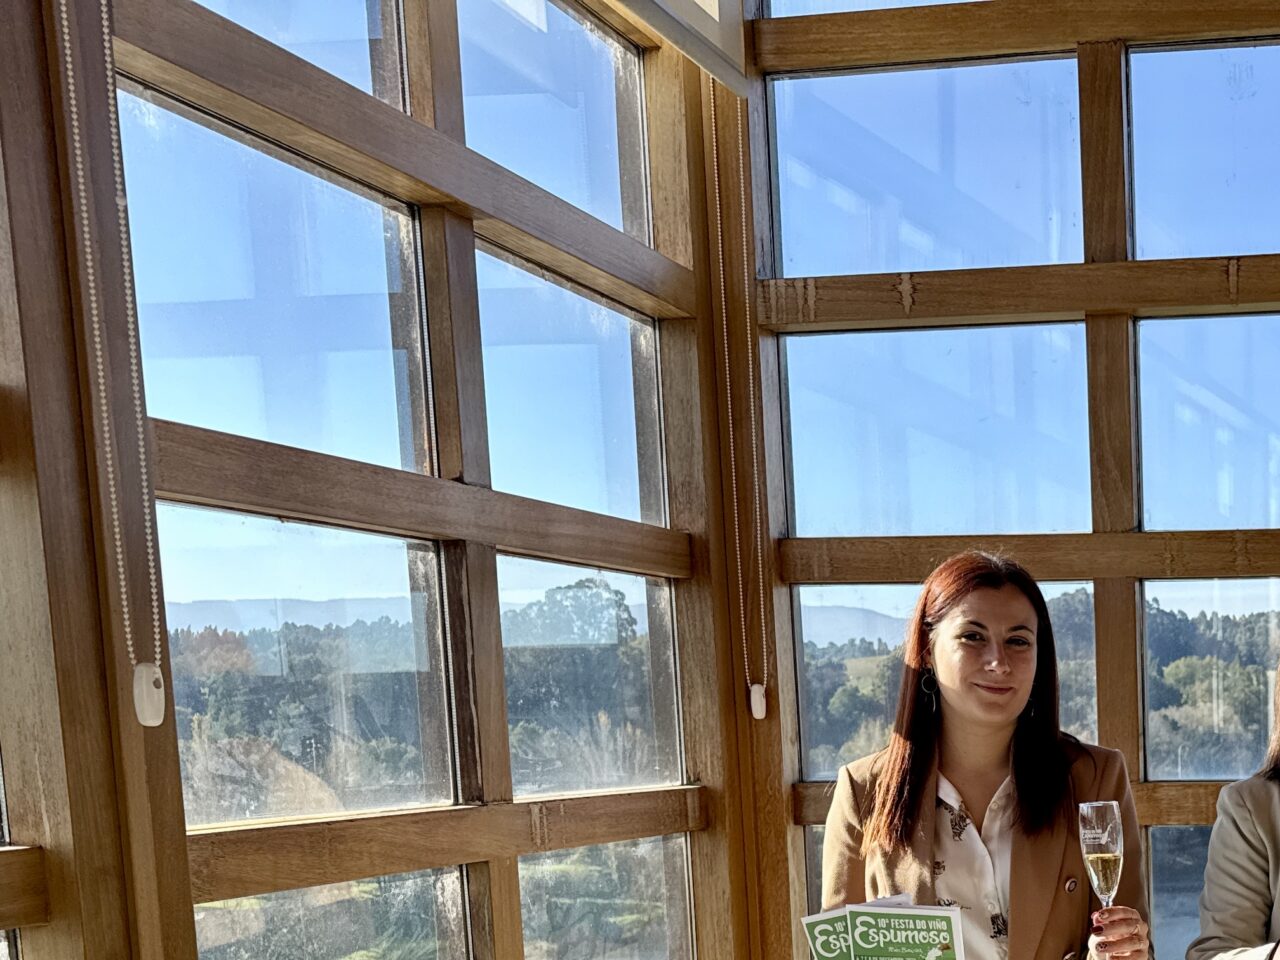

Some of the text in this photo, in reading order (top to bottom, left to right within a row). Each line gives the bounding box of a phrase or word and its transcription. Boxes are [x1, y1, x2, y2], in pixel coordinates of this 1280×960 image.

[854, 916, 950, 949] Espumoso
[891, 919, 914, 929] FESTA
[916, 920, 926, 929] DO
[927, 919, 948, 930] VIÑO
